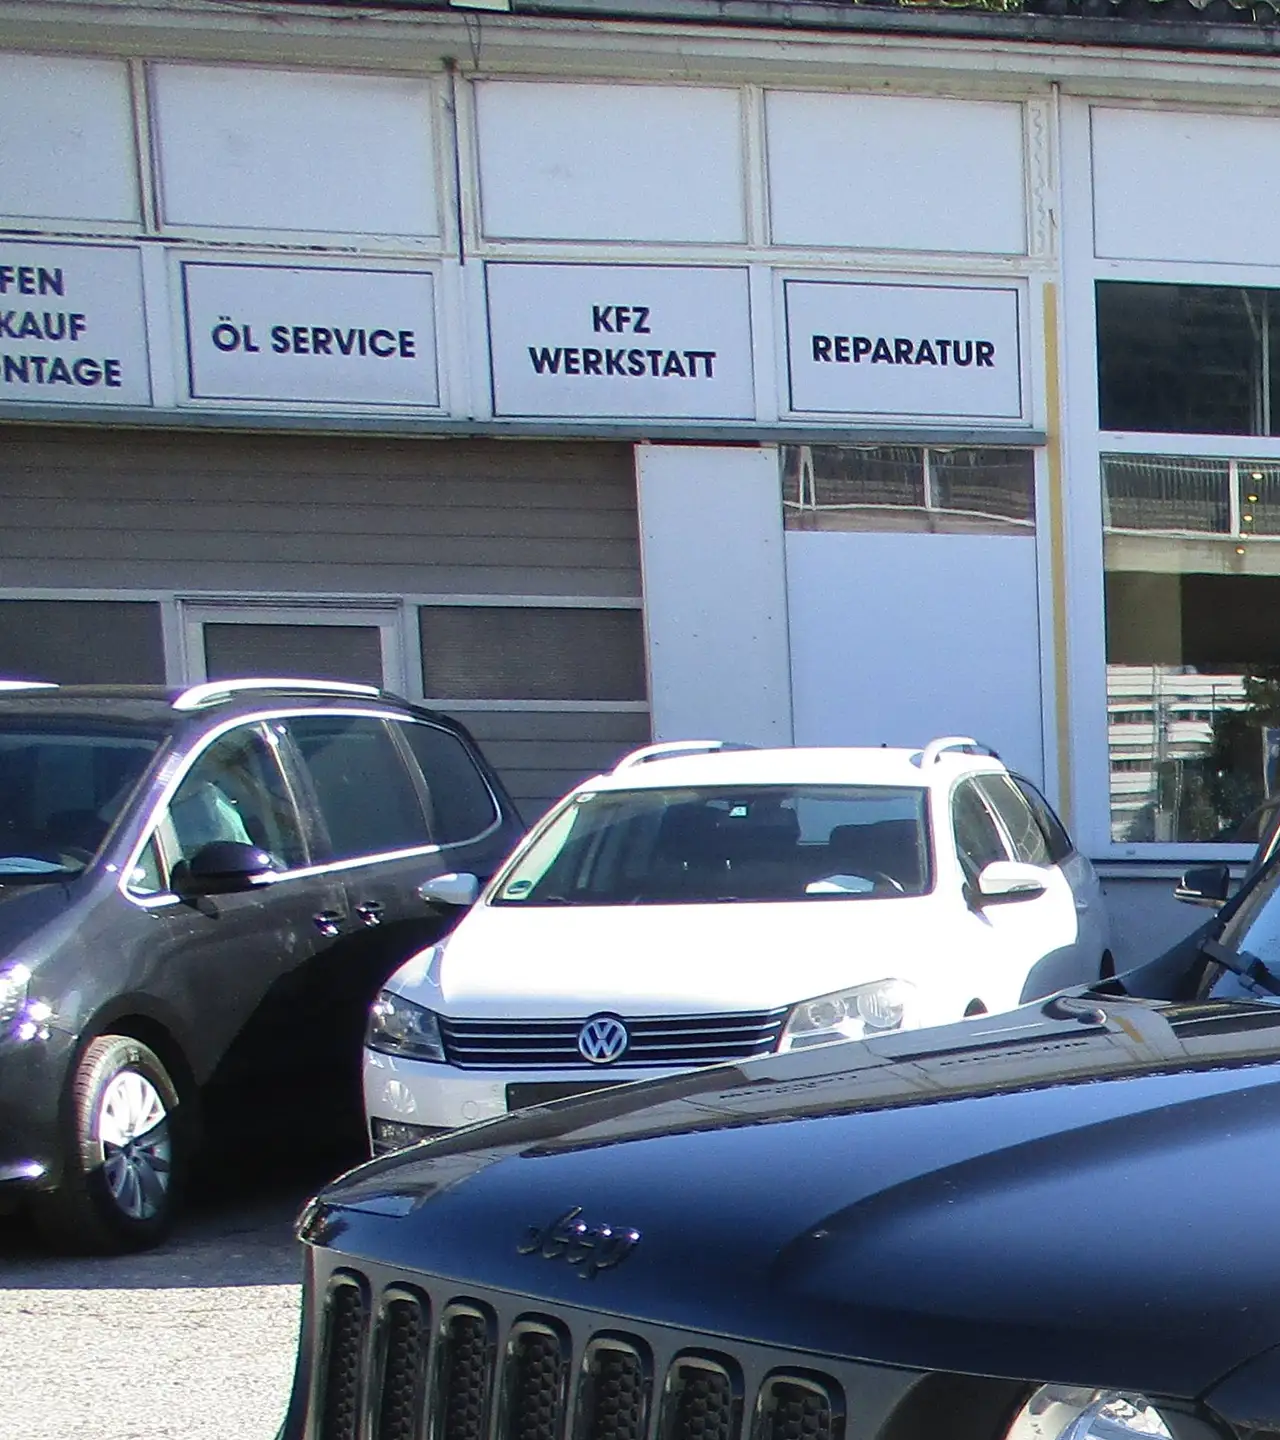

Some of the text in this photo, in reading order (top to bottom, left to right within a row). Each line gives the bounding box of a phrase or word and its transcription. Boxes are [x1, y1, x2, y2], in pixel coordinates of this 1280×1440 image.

[592, 304, 651, 334] KFZ
[212, 316, 417, 358] ÖL SERVICE
[812, 335, 996, 368] REPARATUR
[528, 346, 716, 379] WERKSTATT
